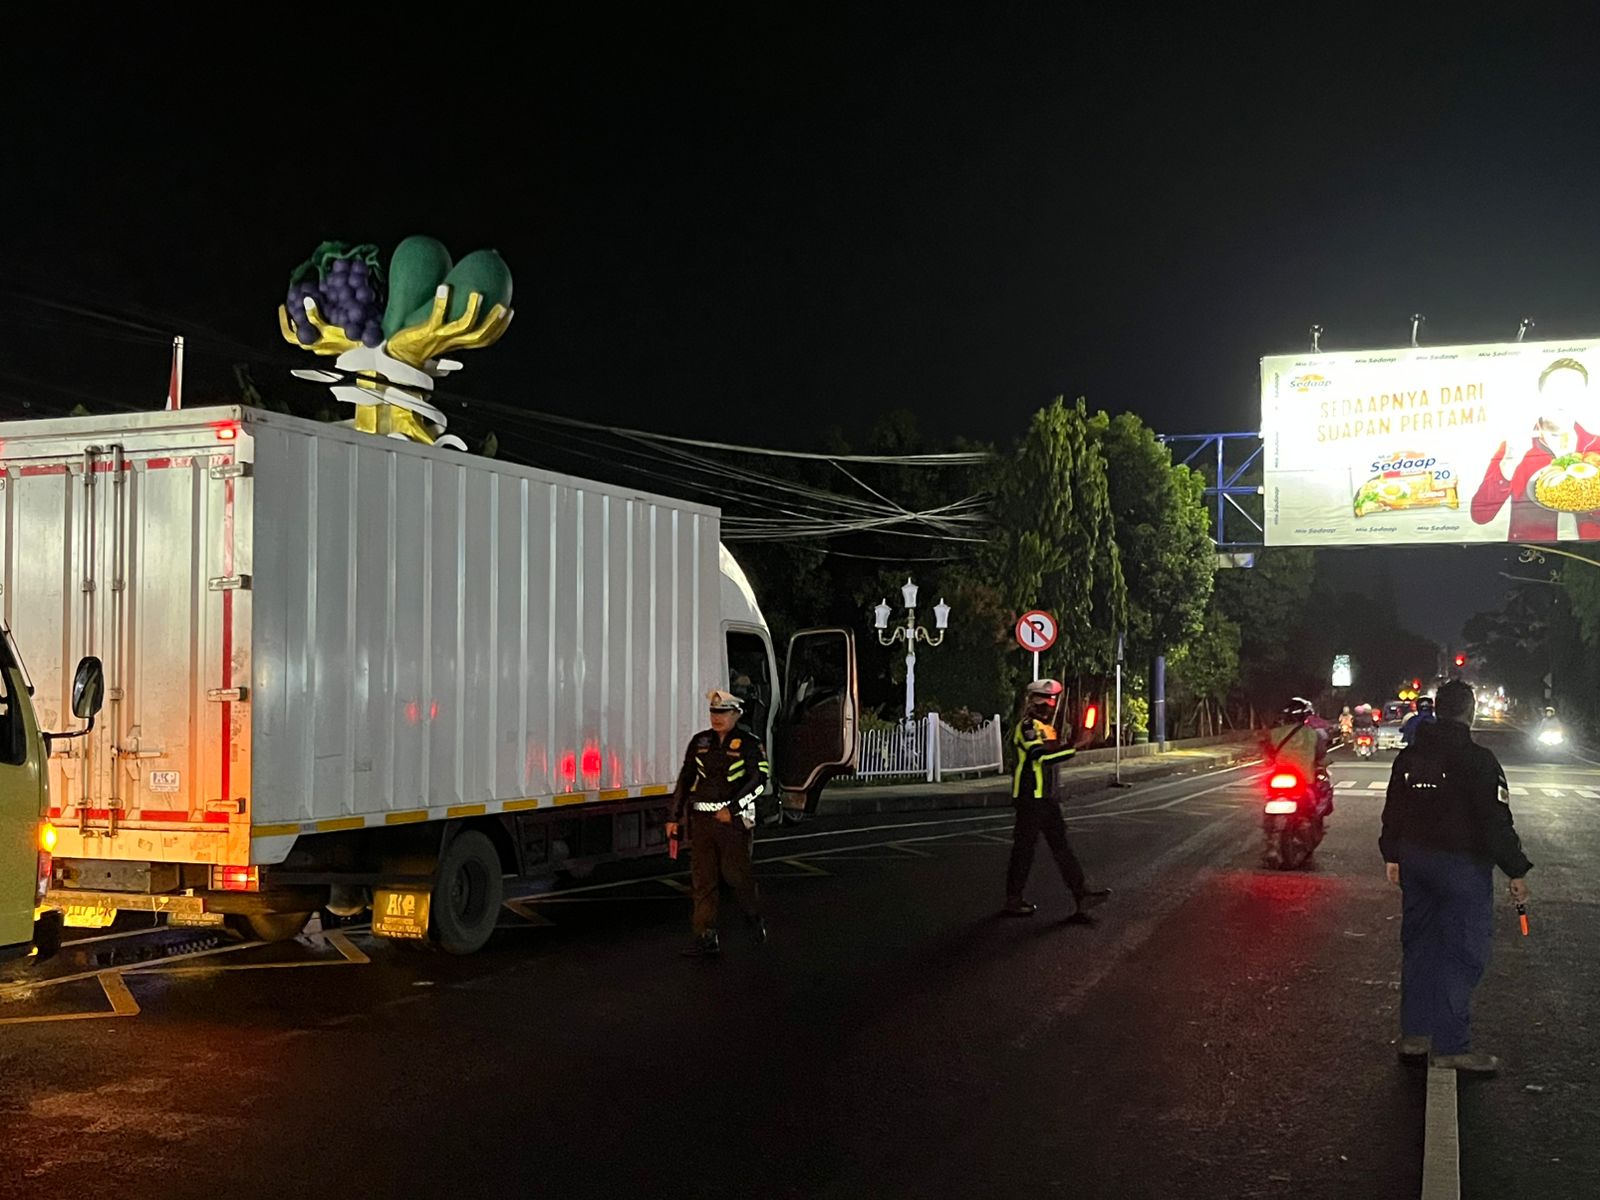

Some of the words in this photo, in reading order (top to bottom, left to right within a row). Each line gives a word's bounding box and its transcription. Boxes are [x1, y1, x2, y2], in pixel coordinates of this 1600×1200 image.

[1320, 389, 1430, 419] SEDAAPNYA
[1440, 382, 1484, 406] DARI
[1317, 416, 1391, 443] SUAPAN
[1401, 405, 1487, 433] PERTAMA
[1369, 457, 1437, 473] Sedaap
[1434, 469, 1451, 480] 20
